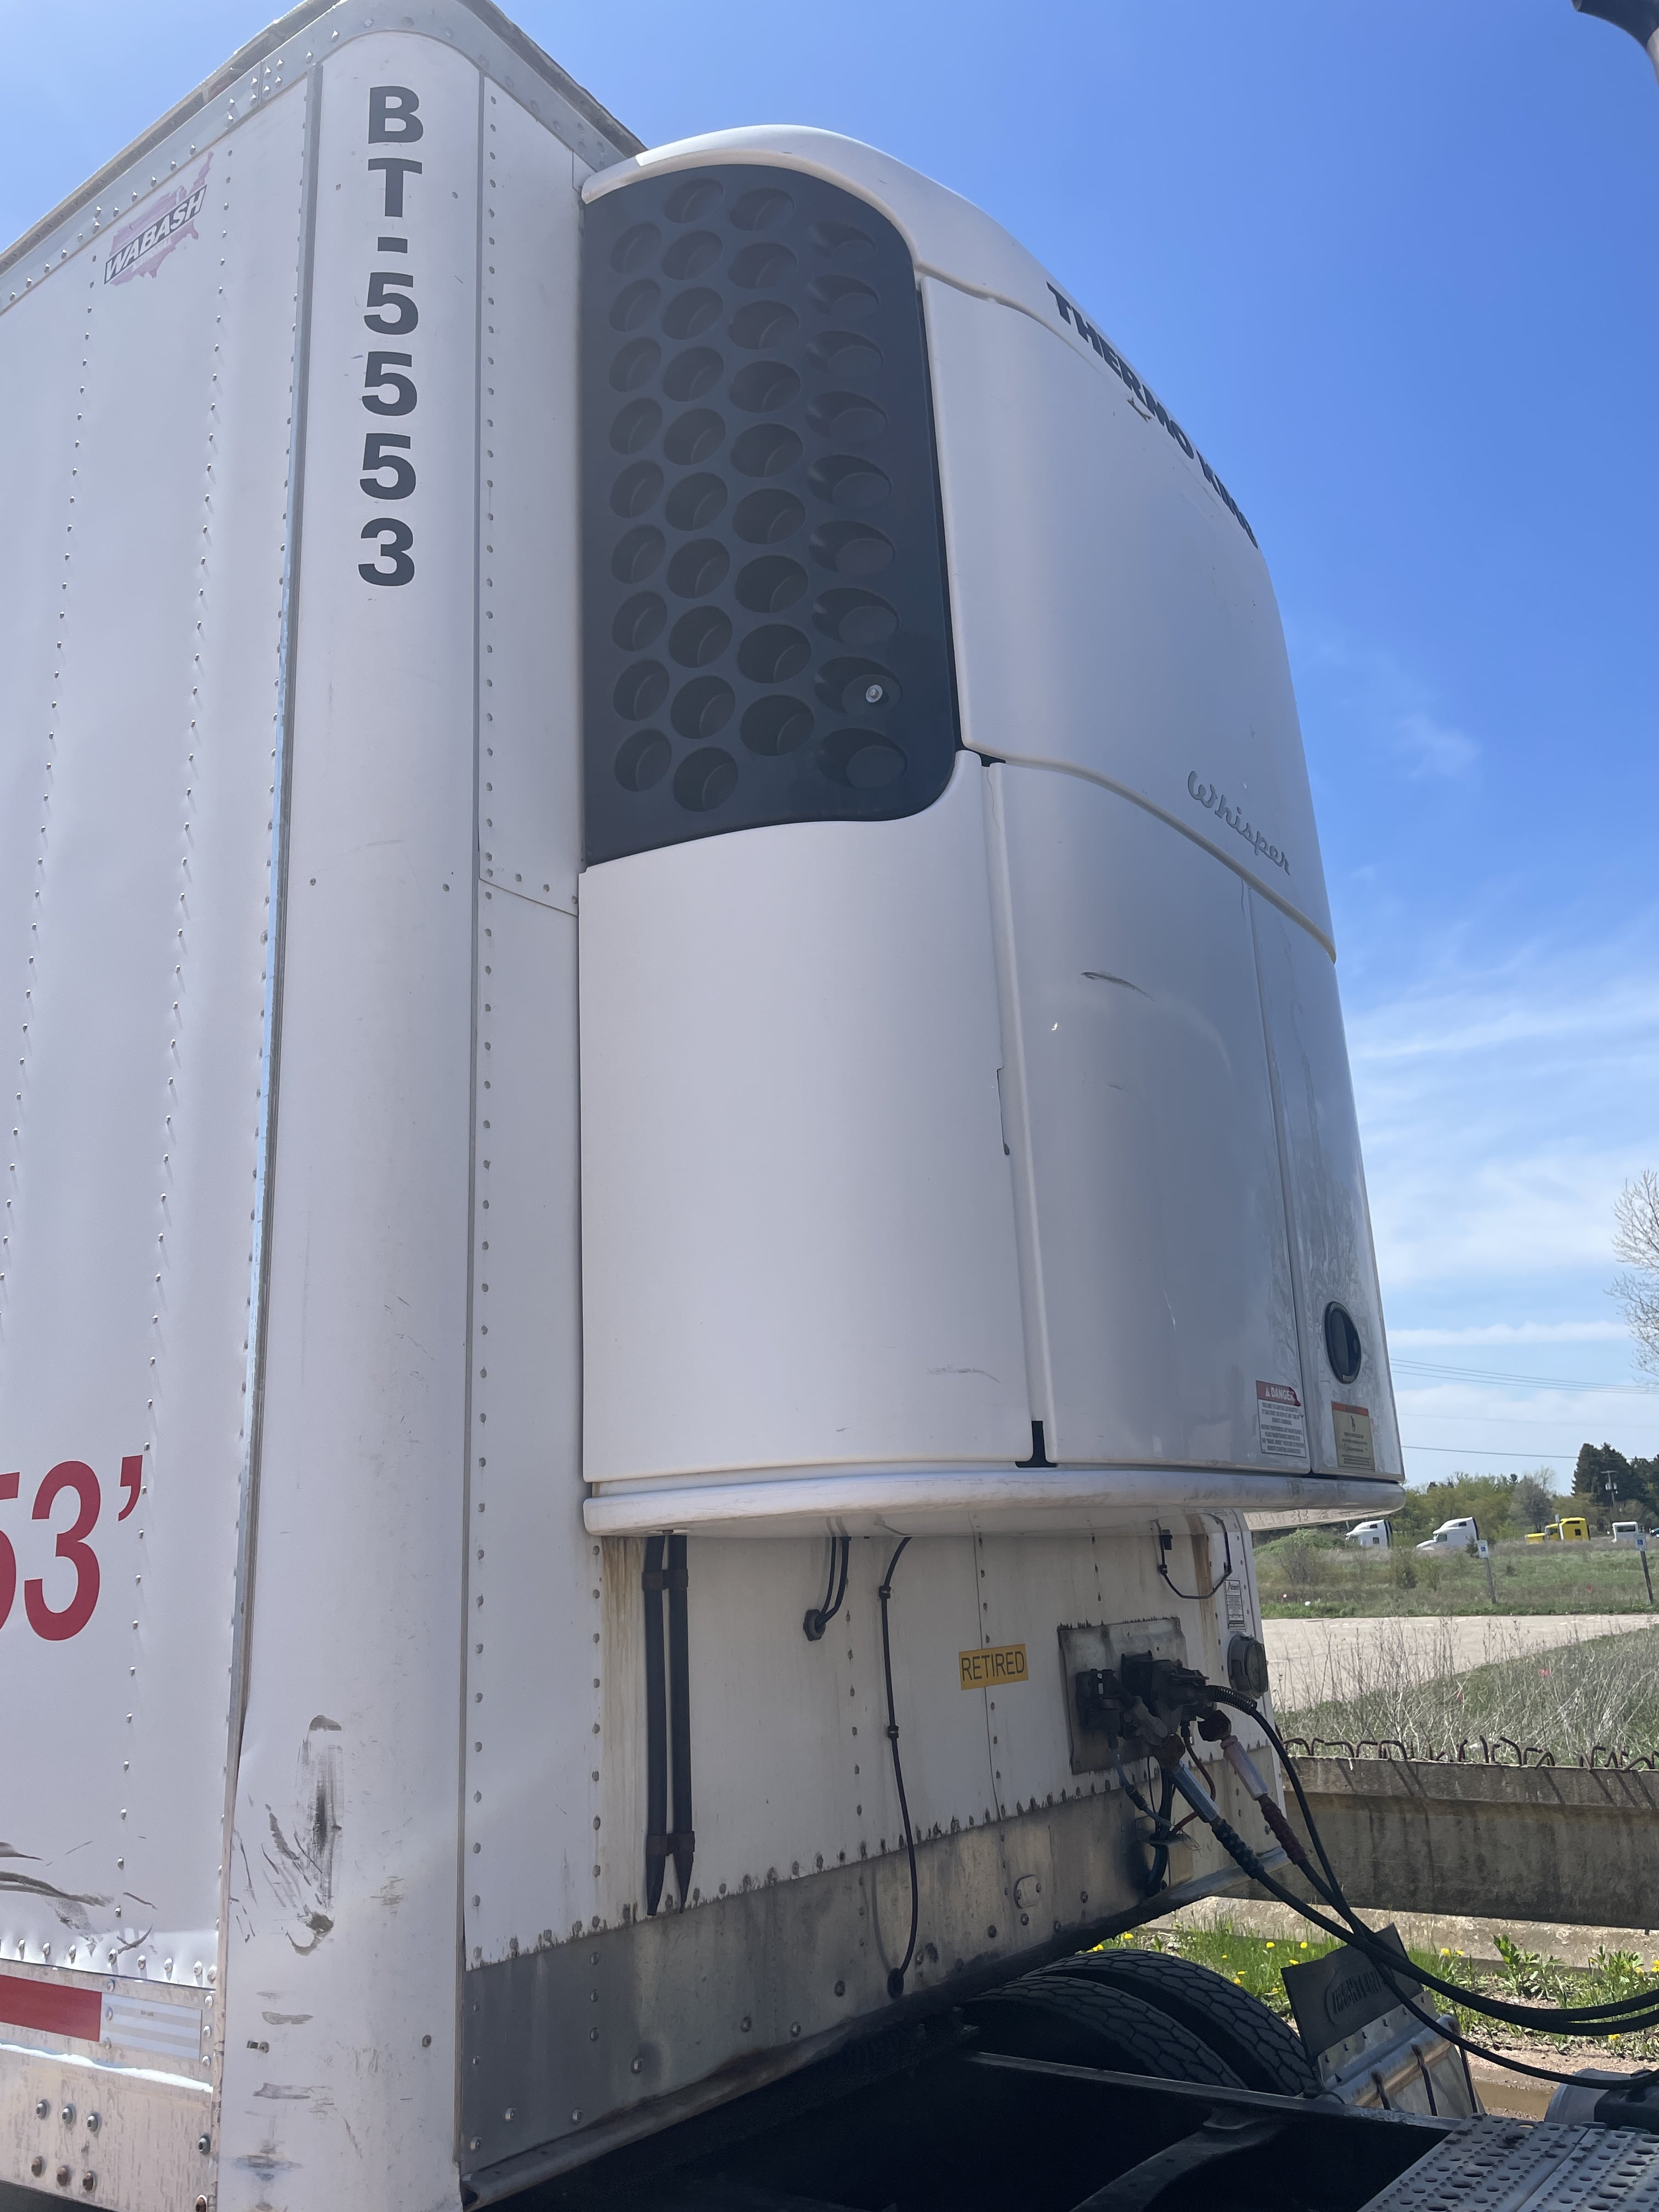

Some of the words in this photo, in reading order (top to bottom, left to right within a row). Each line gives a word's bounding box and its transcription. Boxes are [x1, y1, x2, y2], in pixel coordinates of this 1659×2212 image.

[106, 187, 206, 283] WABASH
[358, 86, 424, 586] BT-5553
[1046, 280, 1194, 460] THERMO
[1187, 770, 1290, 876] Whisper
[1270, 1386, 1296, 1402] DANGER
[0, 1454, 143, 1641] 3'
[961, 1650, 1025, 1681] RETIRED
